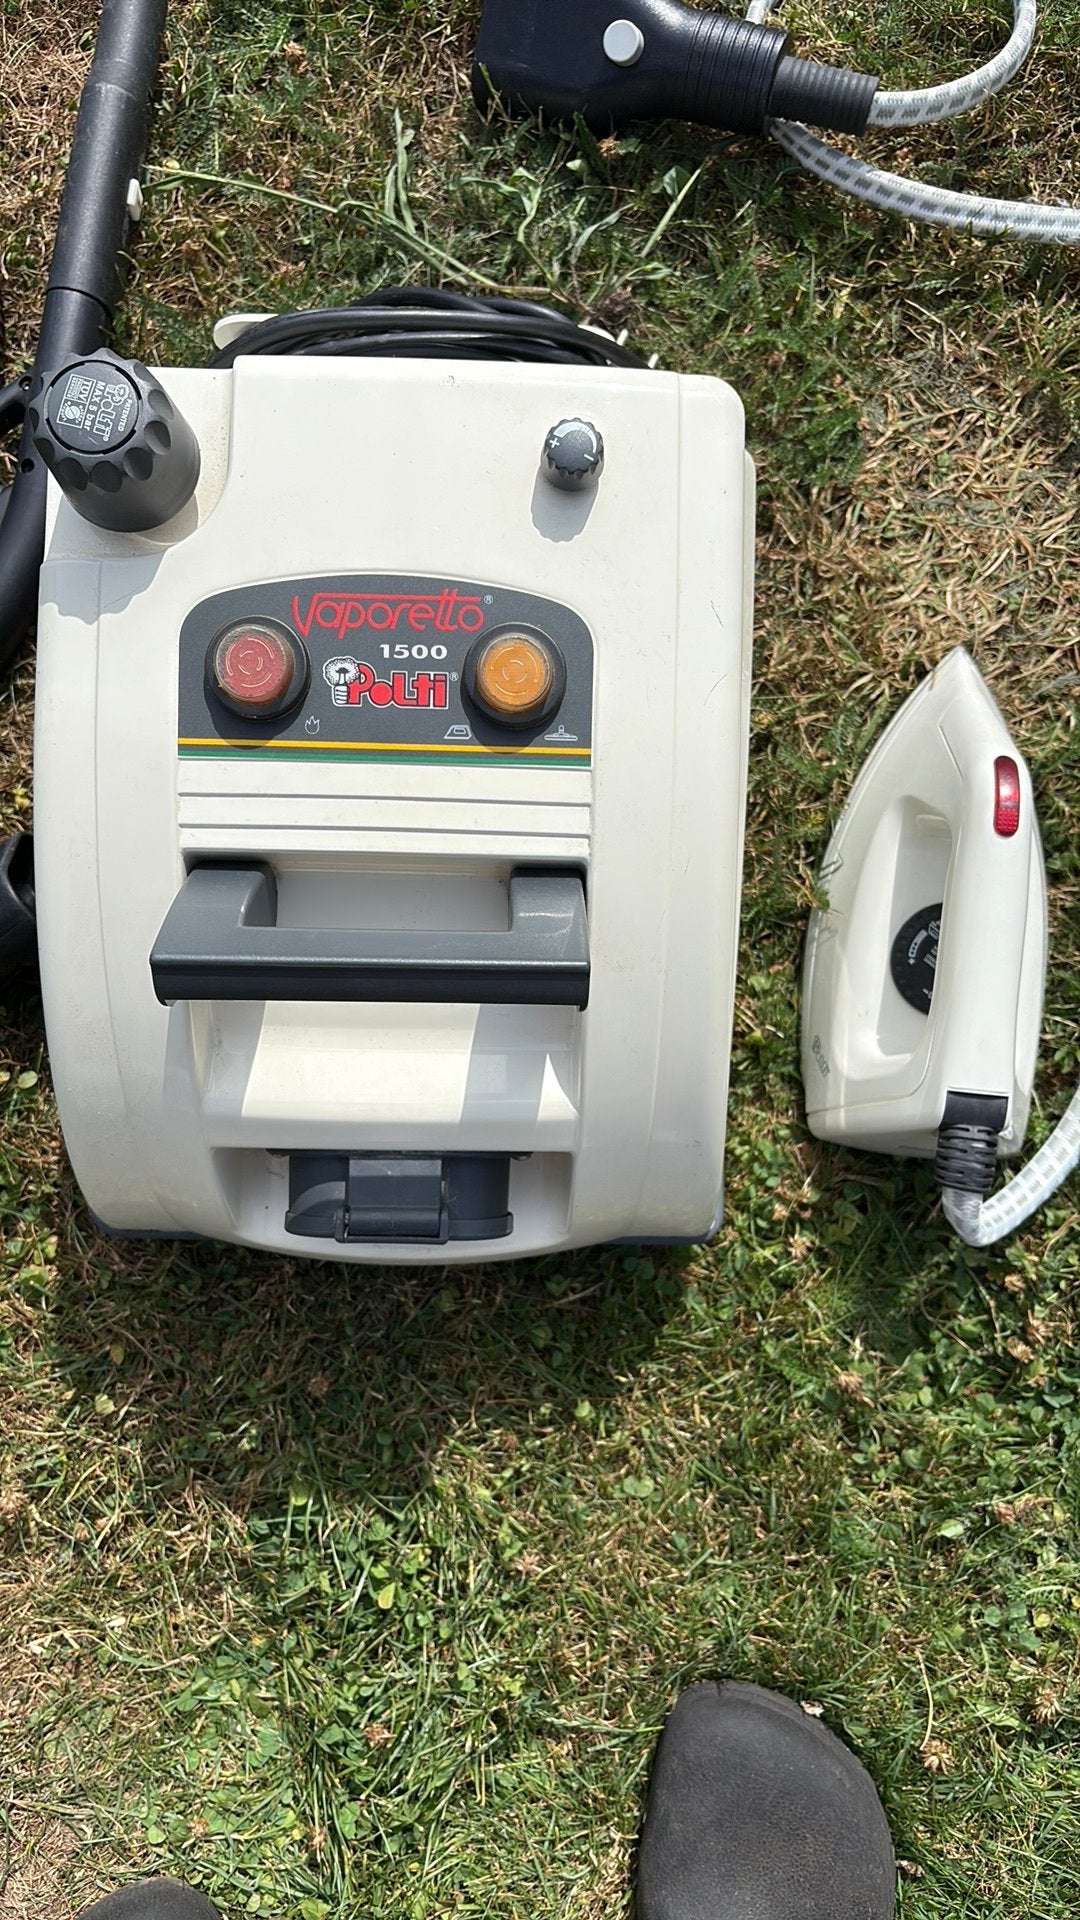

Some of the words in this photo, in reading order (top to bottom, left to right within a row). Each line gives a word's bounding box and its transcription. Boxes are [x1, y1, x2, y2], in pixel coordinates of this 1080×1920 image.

[92, 380, 106, 403] MAX
[89, 404, 98, 412] 5
[118, 398, 132, 431] PATENTED
[84, 413, 96, 431] bar
[379, 644, 448, 660] 1500
